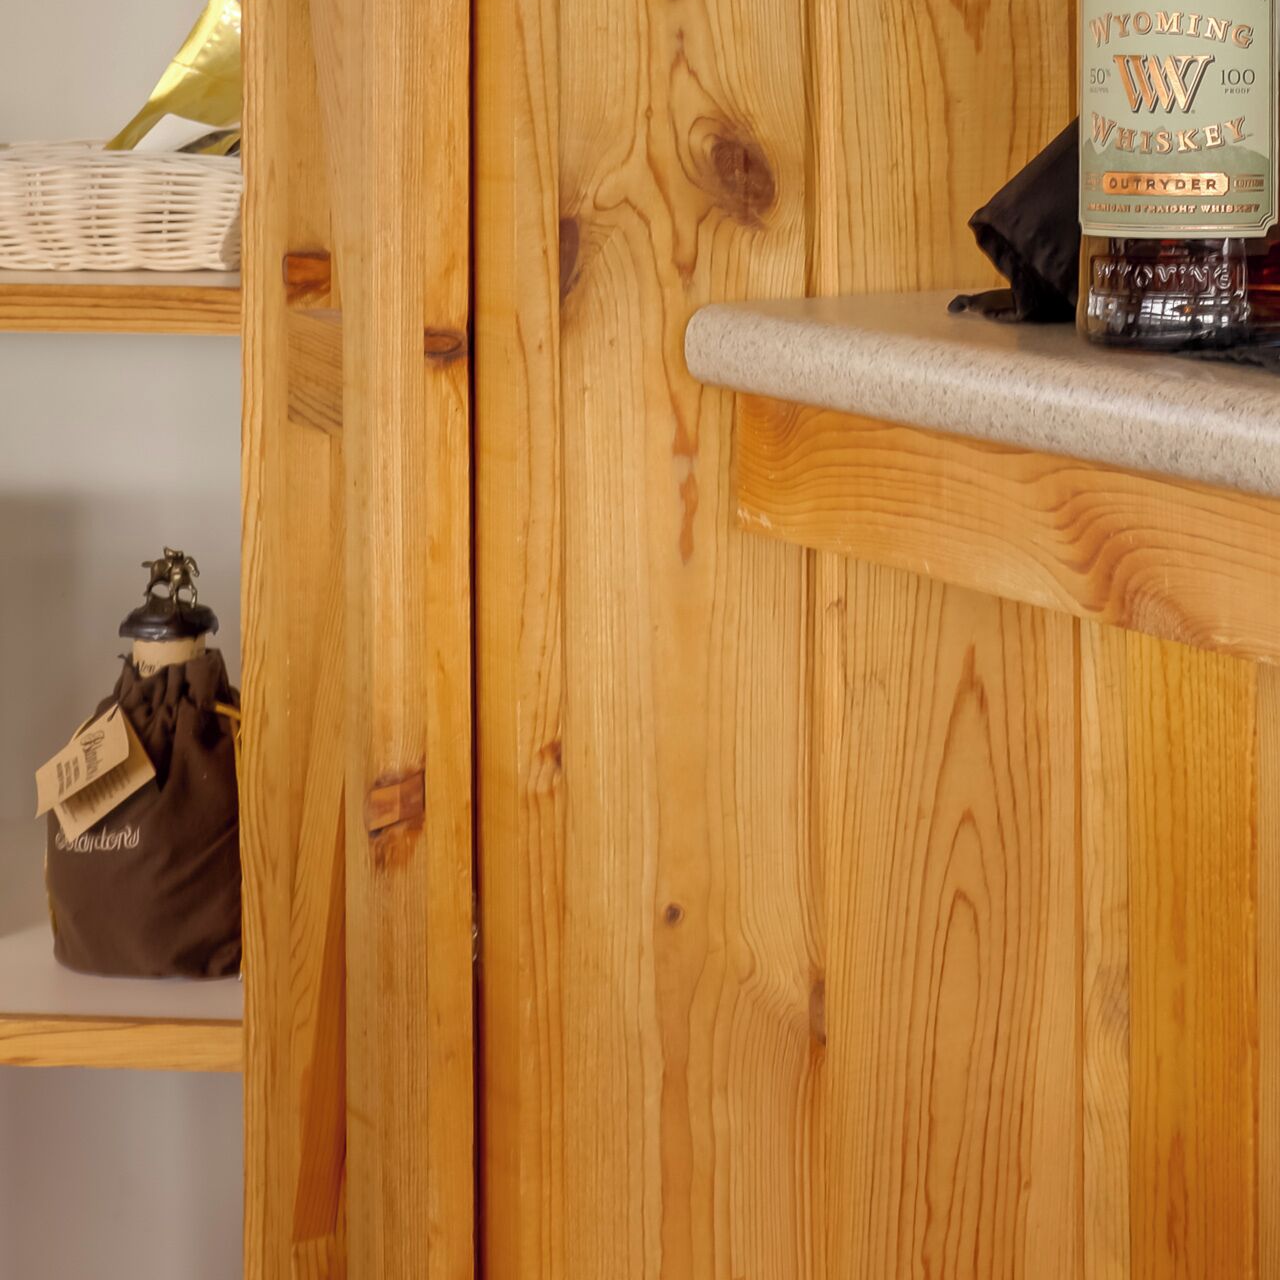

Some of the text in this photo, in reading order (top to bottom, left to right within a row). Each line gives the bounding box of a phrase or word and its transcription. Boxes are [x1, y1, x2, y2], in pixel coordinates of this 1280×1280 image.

[1088, 10, 1256, 49] WYOMING
[1220, 68, 1256, 86] 100
[1091, 111, 1246, 155] WHISKEY
[1109, 177, 1218, 190] OUTRYDER
[1135, 204, 1197, 214] STRAIGHT
[1200, 203, 1261, 214] WHISKEY
